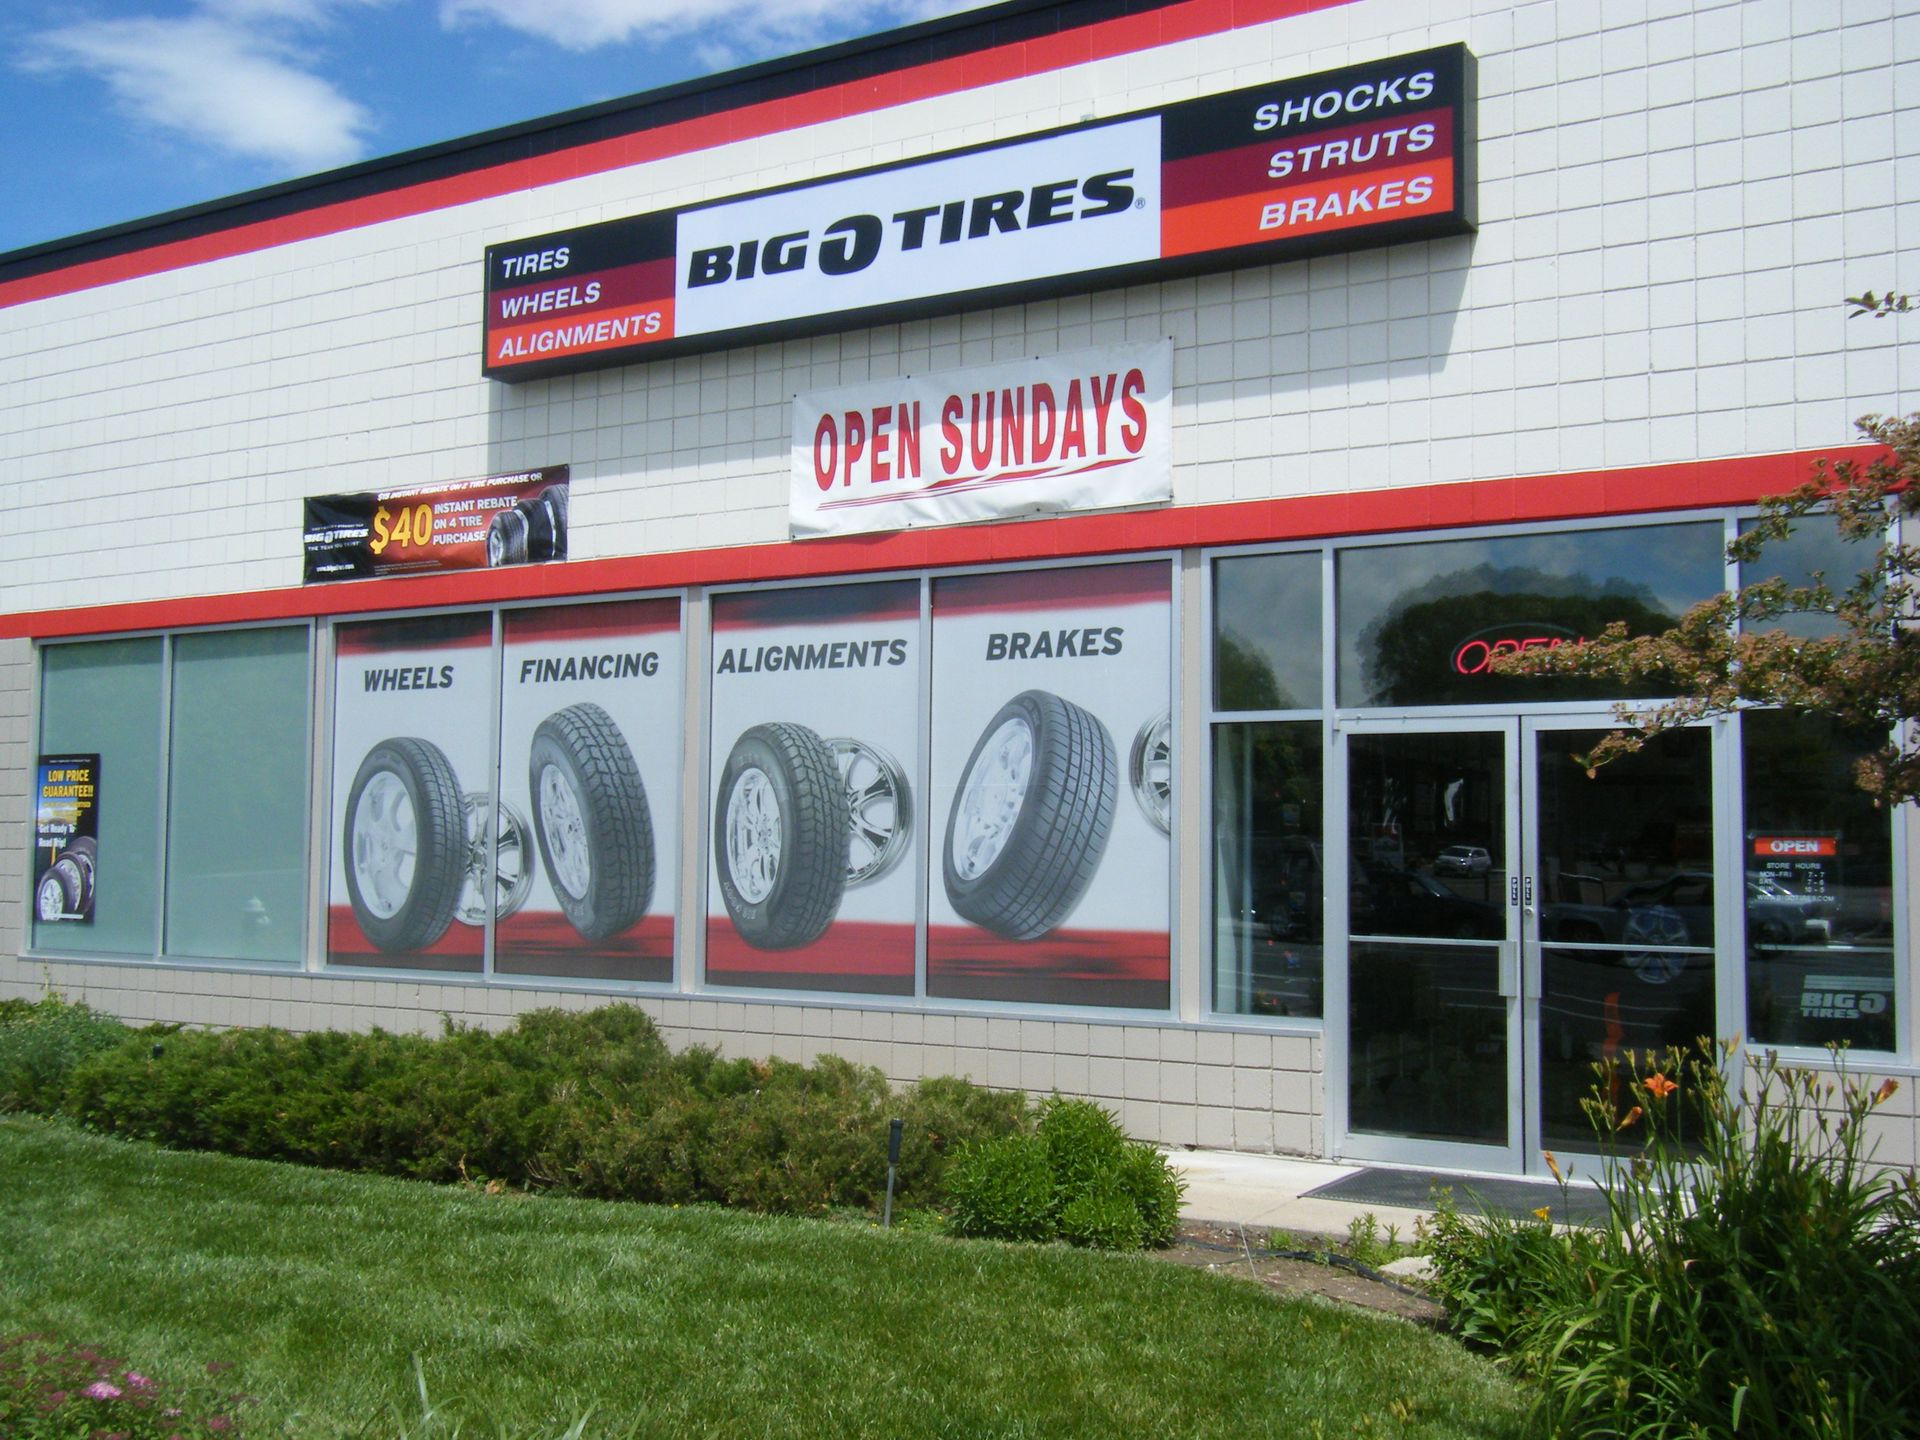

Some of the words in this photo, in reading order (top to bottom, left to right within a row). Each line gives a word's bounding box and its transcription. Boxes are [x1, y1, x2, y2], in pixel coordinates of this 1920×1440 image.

[1253, 71, 1435, 132] SHOCKS
[1267, 123, 1435, 179] STRUTS
[1259, 176, 1434, 231] BRAKES
[502, 247, 570, 279] TIRES
[502, 282, 601, 319] WHEELS
[498, 311, 661, 359] ALIGNMENTS
[813, 400, 920, 492] OPEN
[940, 368, 1147, 475] SUNDAYS
[469, 480, 486, 489] TIRE
[487, 473, 530, 486] PURCHASE
[530, 472, 543, 481] OR
[434, 500, 475, 515] INSTANT
[477, 496, 518, 510] REBATE
[370, 504, 433, 554] $40
[432, 530, 486, 546] PURCHASE
[433, 519, 447, 530] ON
[449, 518, 457, 528] 4
[458, 515, 483, 526] TIRE
[716, 638, 908, 675] ALIGNMENTS
[986, 626, 1124, 662] BRAKES
[364, 665, 454, 693] WHEELS
[520, 651, 659, 684] FINANCING
[48, 770, 64, 782] LOW
[66, 769, 90, 781] PRICE
[1770, 840, 1818, 852] OPEN
[1801, 992, 1855, 1008] BIG
[1802, 1008, 1860, 1019] TIRES
